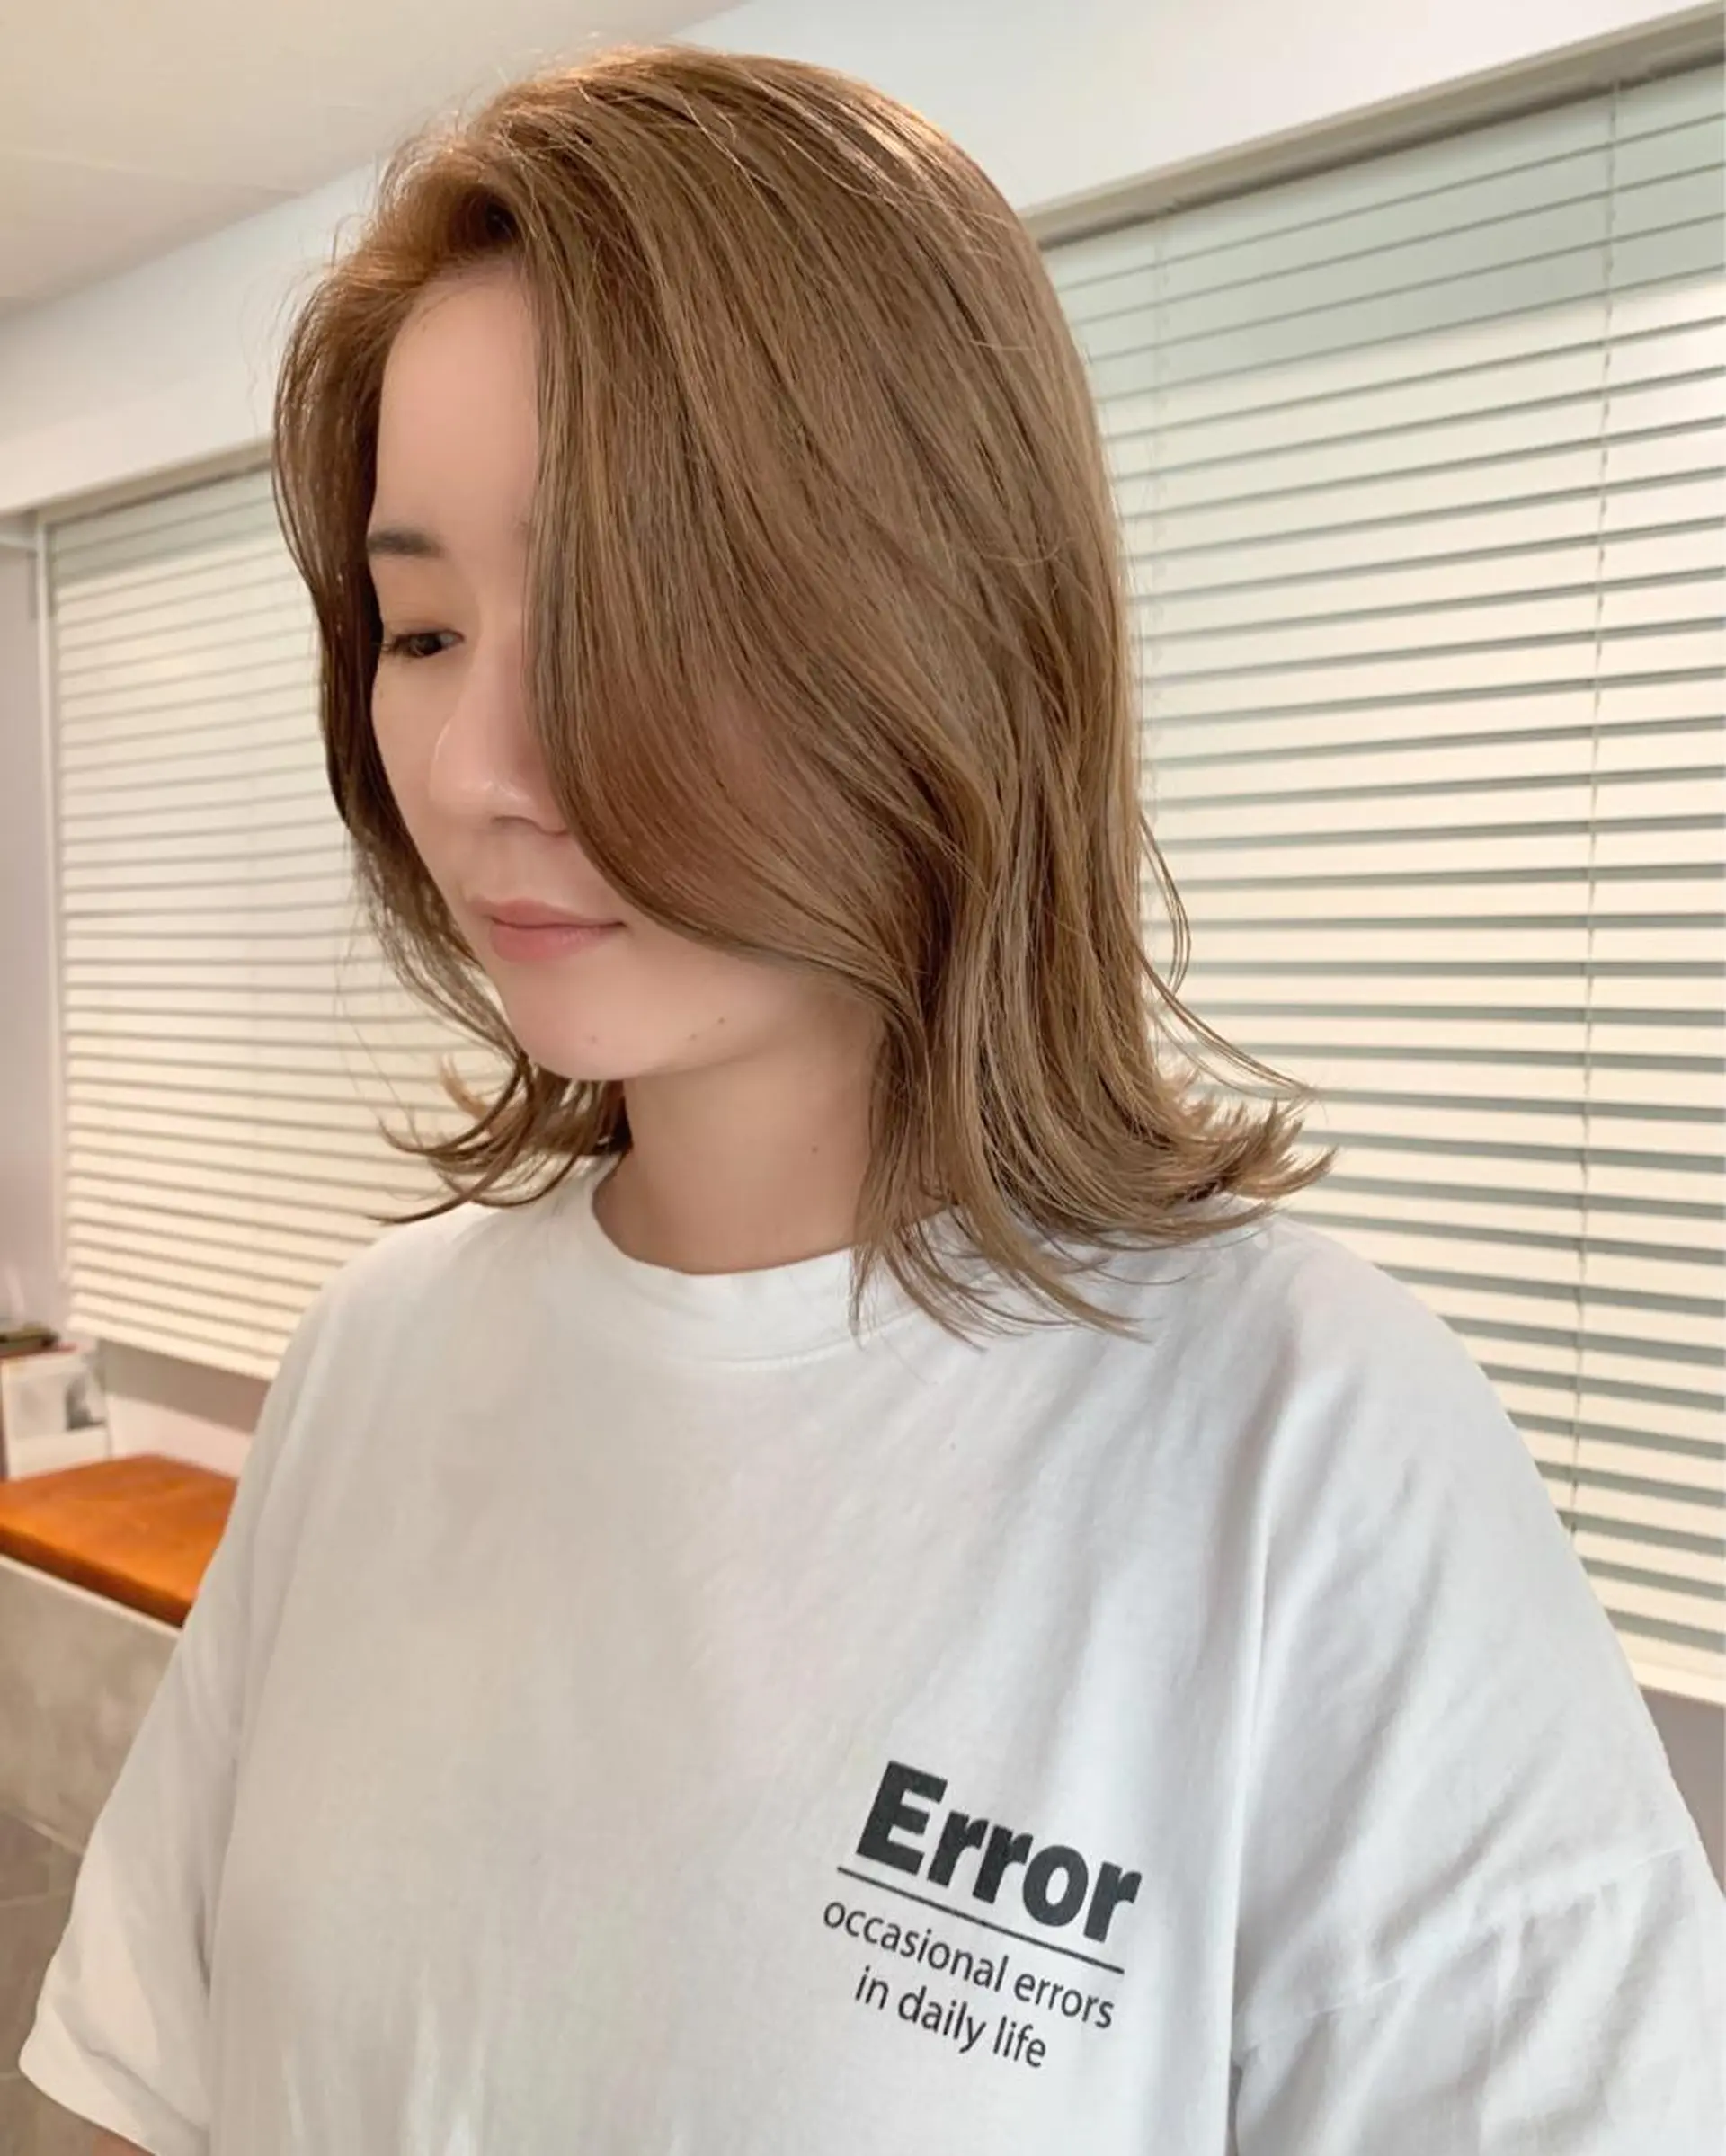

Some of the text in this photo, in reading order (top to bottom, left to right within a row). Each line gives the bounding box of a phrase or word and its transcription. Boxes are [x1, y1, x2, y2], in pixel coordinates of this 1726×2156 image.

[855, 1761, 1143, 1943] Error
[823, 1901, 1115, 2029] occasional errors
[855, 1965, 1045, 2068] in daily life
